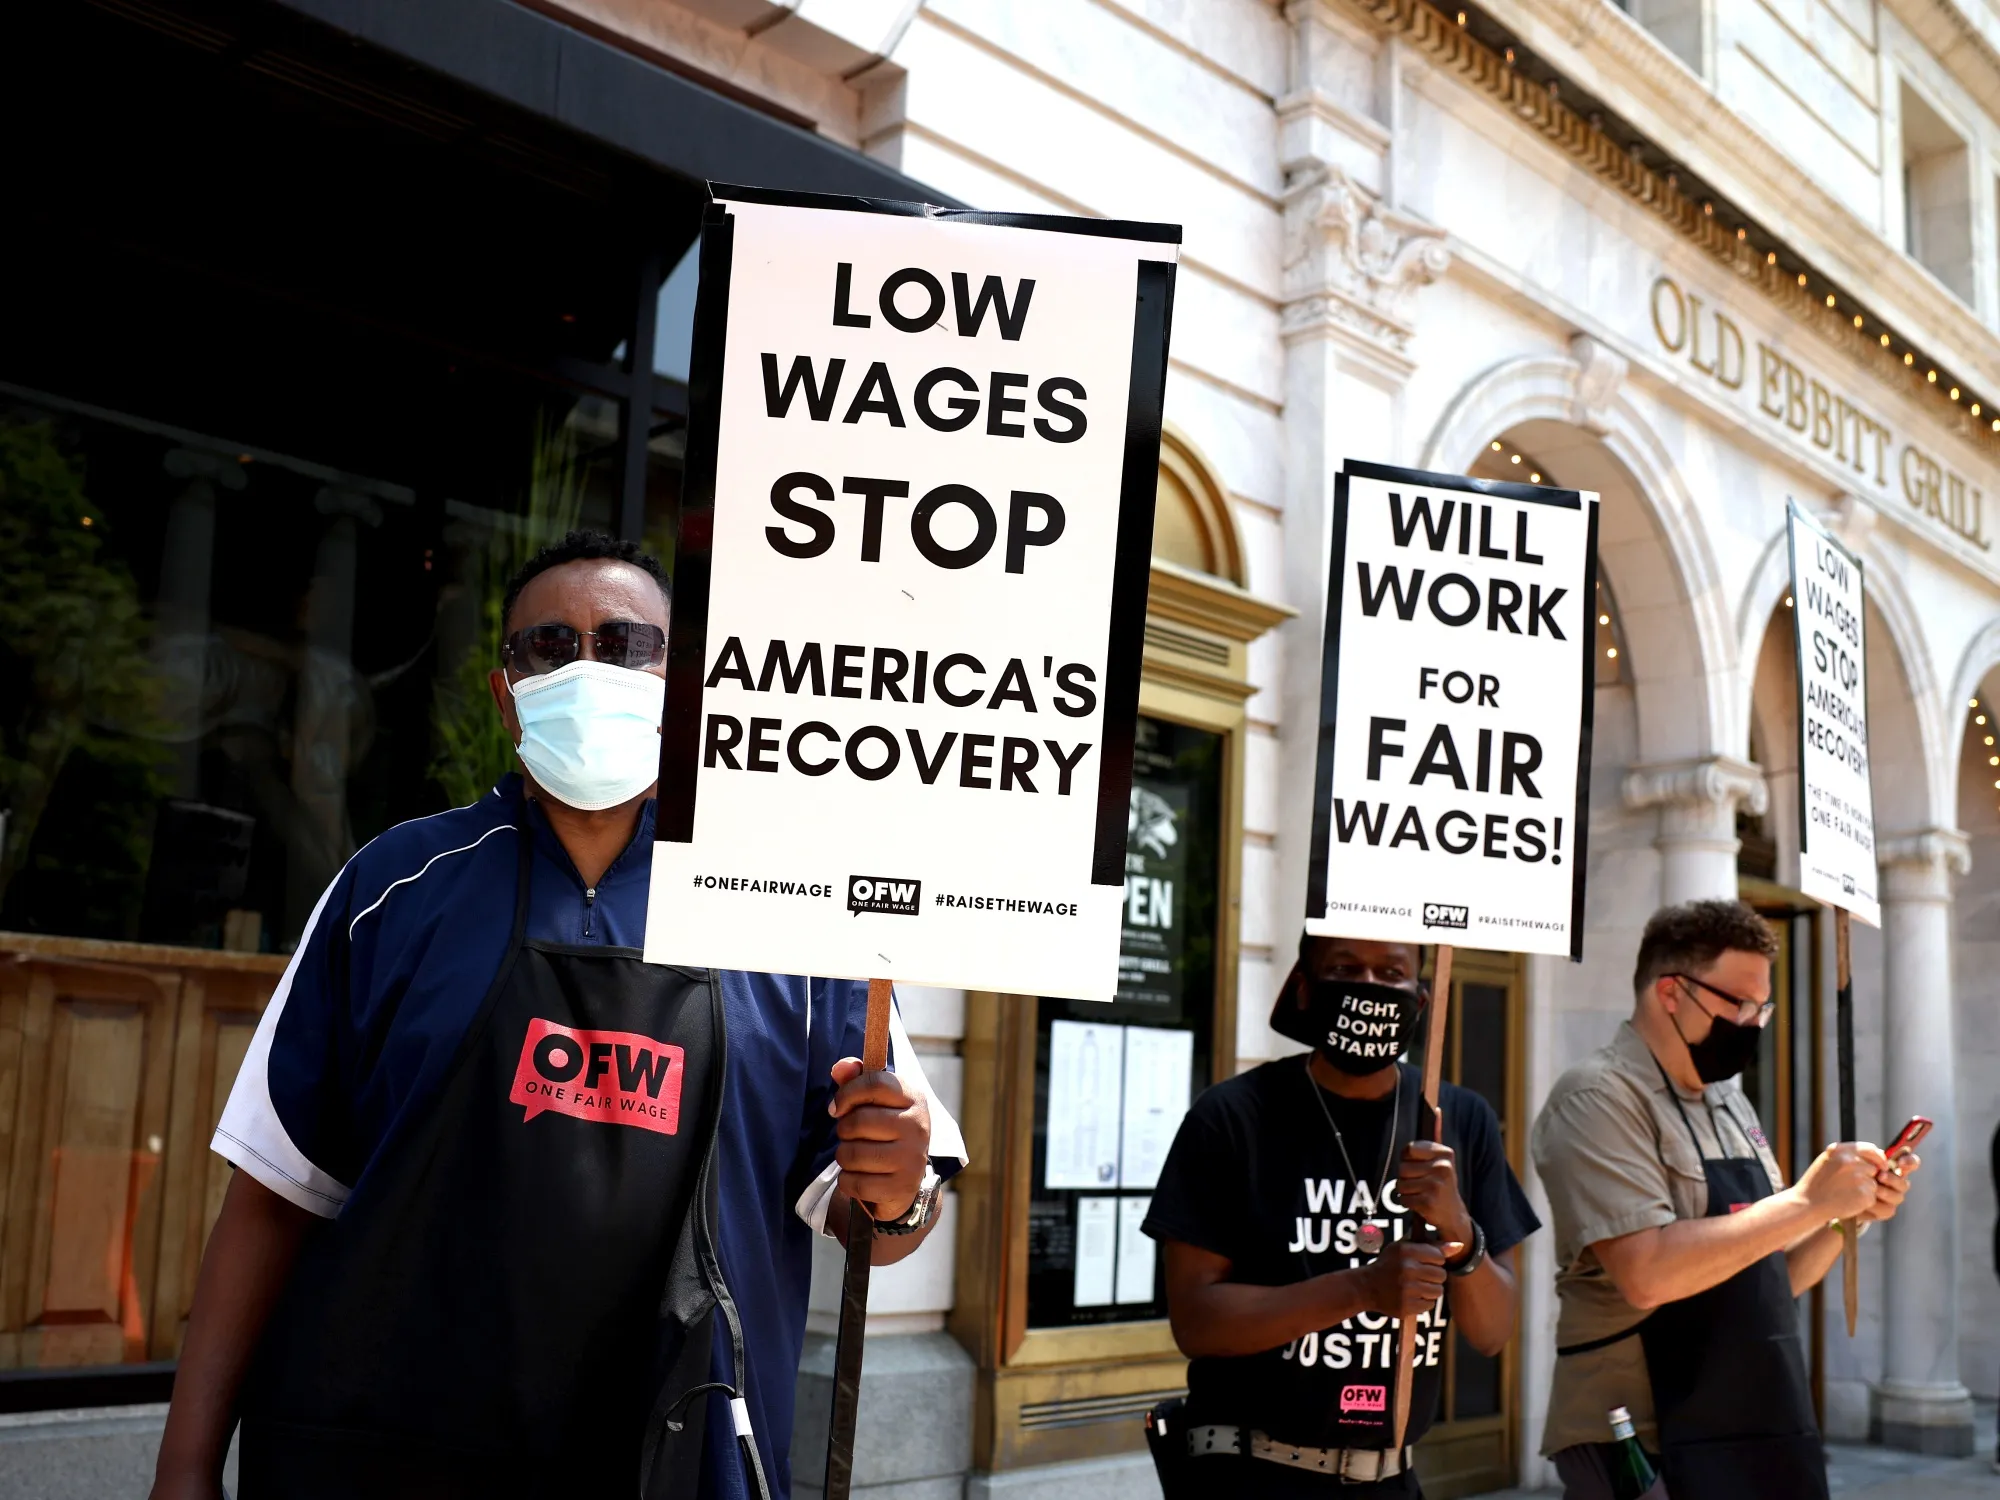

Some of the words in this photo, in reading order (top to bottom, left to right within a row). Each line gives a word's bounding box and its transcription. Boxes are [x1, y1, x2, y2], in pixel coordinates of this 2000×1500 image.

[833, 262, 1036, 341] LOW
[760, 352, 1088, 443] WAGES
[1651, 276, 1744, 390] OLD
[1758, 342, 1892, 487] EBBITT
[1900, 445, 1991, 552] GRILL
[765, 471, 1066, 574] STOP
[1388, 492, 1544, 566] WILL
[1816, 541, 1848, 593] LOW
[1357, 561, 1568, 641] WORK
[1805, 577, 1859, 648] WAGES
[704, 636, 1098, 718] AMERICA'S
[1419, 667, 1500, 708] FOR
[1813, 630, 1858, 697] STOP
[703, 713, 1093, 796] RECOVERY
[1366, 716, 1543, 799] FAIR
[1333, 798, 1563, 865] WAGES!
[693, 874, 833, 898] #ONEFAIRWAGE
[852, 879, 917, 903] OFW
[935, 893, 1078, 917] #RAISETHEWAGE
[852, 900, 869, 908] ONE
[892, 903, 915, 911] WAGE
[1425, 905, 1466, 922] OFW
[1336, 1014, 1400, 1037] DON'T
[1341, 995, 1401, 1020] FIGHT,
[533, 1033, 671, 1100] OFW
[1327, 1031, 1399, 1057] STARVE
[525, 1081, 565, 1100] ONE
[573, 1093, 612, 1110] FAIR
[620, 1098, 667, 1120] WAGE
[1344, 1388, 1382, 1402] OFW
